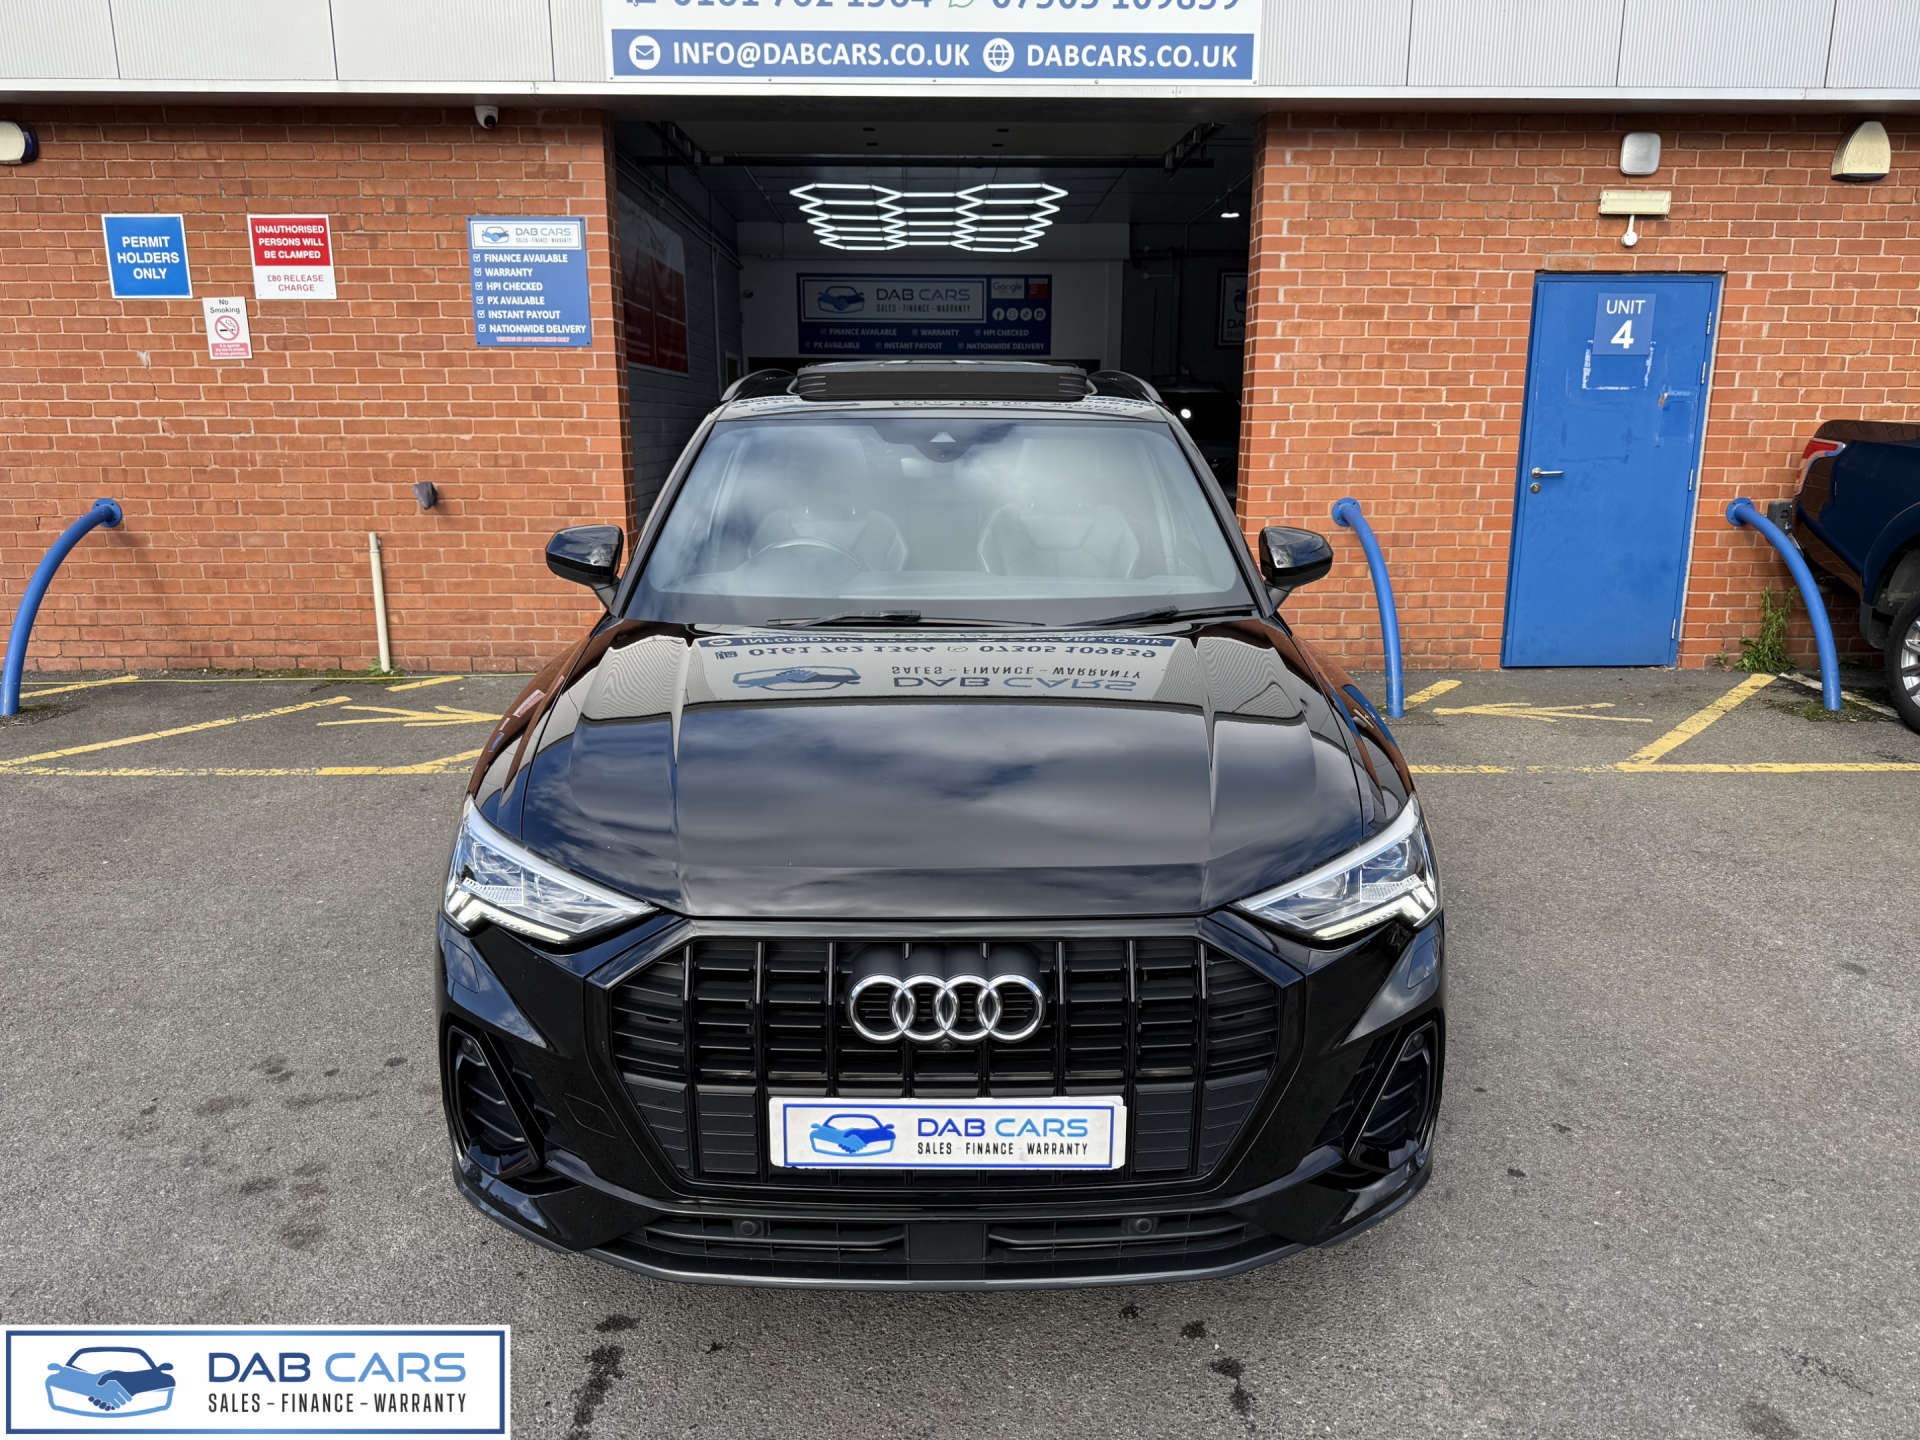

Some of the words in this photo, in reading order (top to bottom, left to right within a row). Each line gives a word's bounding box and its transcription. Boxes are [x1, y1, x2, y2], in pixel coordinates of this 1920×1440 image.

[673, 42, 970, 68] INFO@DABCARS.CO.UK
[1027, 44, 1237, 67] DABCARS.CO.UK
[255, 225, 325, 234] UNAUTHORISED
[515, 227, 538, 236] DAB
[540, 227, 571, 236] CARS
[121, 236, 170, 248] PERMIT
[258, 238, 301, 247] PERSONS
[302, 238, 324, 247] WILL
[117, 252, 180, 264] HOLDERS
[264, 250, 277, 259] BE
[278, 250, 321, 259] CLAMPED
[484, 254, 521, 263] FINANCE
[522, 254, 568, 263] AVAILABLE
[133, 268, 167, 280] ONLY
[485, 268, 533, 277] WARRANTY
[267, 274, 282, 282] £80
[284, 274, 324, 282] RELEASE
[278, 283, 316, 292] CHARGE
[486, 282, 501, 291] HPI
[503, 282, 543, 291] CHECKED
[876, 288, 914, 301] DAB
[918, 288, 970, 301] CARS
[487, 296, 499, 305] PX
[500, 296, 545, 305] AVAILABLE
[210, 306, 240, 315] Smoking
[1606, 300, 1646, 314] UNIT
[488, 310, 525, 319] INSTANT
[526, 310, 561, 319] PAYOUT
[489, 324, 545, 333] NATIONWIDE
[546, 325, 587, 333] DELIVERY
[1610, 319, 1635, 349] 4
[918, 1118, 986, 1137] DAB
[995, 1118, 1089, 1137] CARS
[918, 1142, 953, 1155] SALES
[965, 1142, 1015, 1155] FINANCE
[1027, 1143, 1089, 1155] WARRANTY
